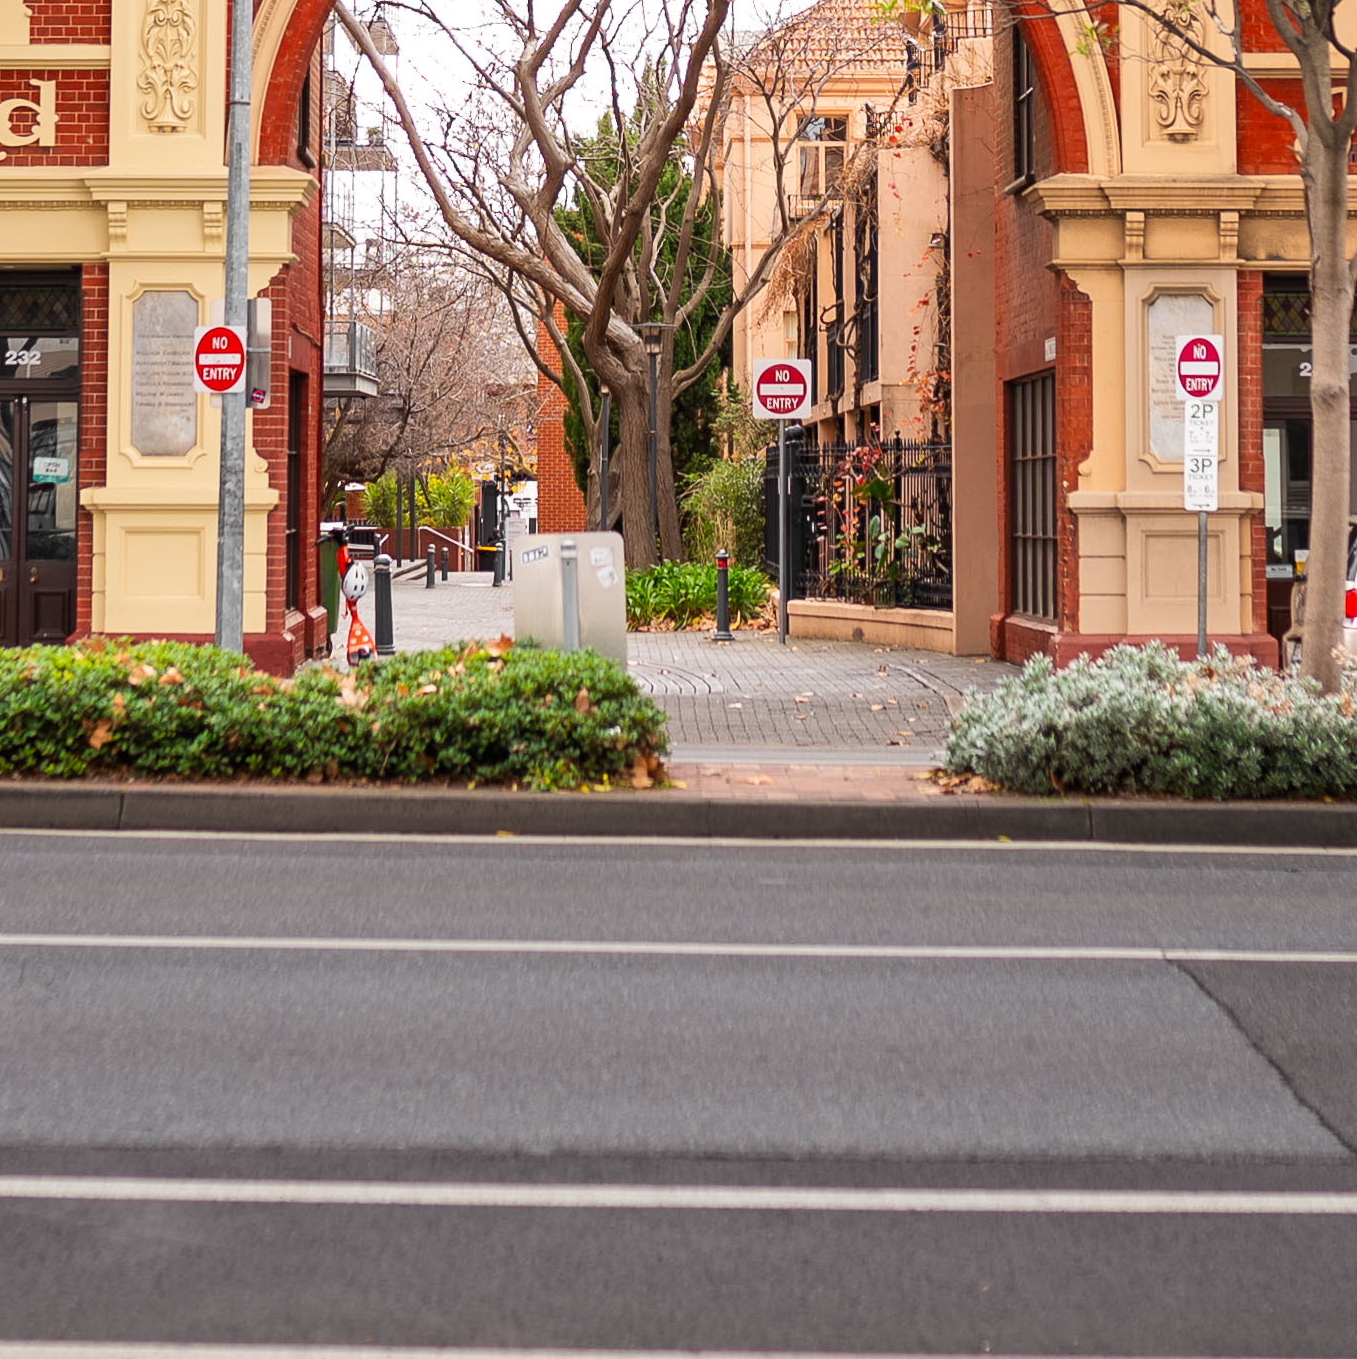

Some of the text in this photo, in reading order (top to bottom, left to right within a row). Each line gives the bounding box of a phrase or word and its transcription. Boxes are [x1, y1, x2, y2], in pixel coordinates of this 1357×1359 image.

[212, 337, 228, 350] NO
[4, 349, 42, 366] 232
[1193, 344, 1207, 360] NO
[203, 367, 237, 381] ENTRY
[775, 369, 790, 383] NO
[1185, 377, 1214, 392] ENTRY
[766, 397, 799, 410] ENTRY
[1190, 404, 1214, 419] 2P
[1190, 458, 1213, 473] 3P
